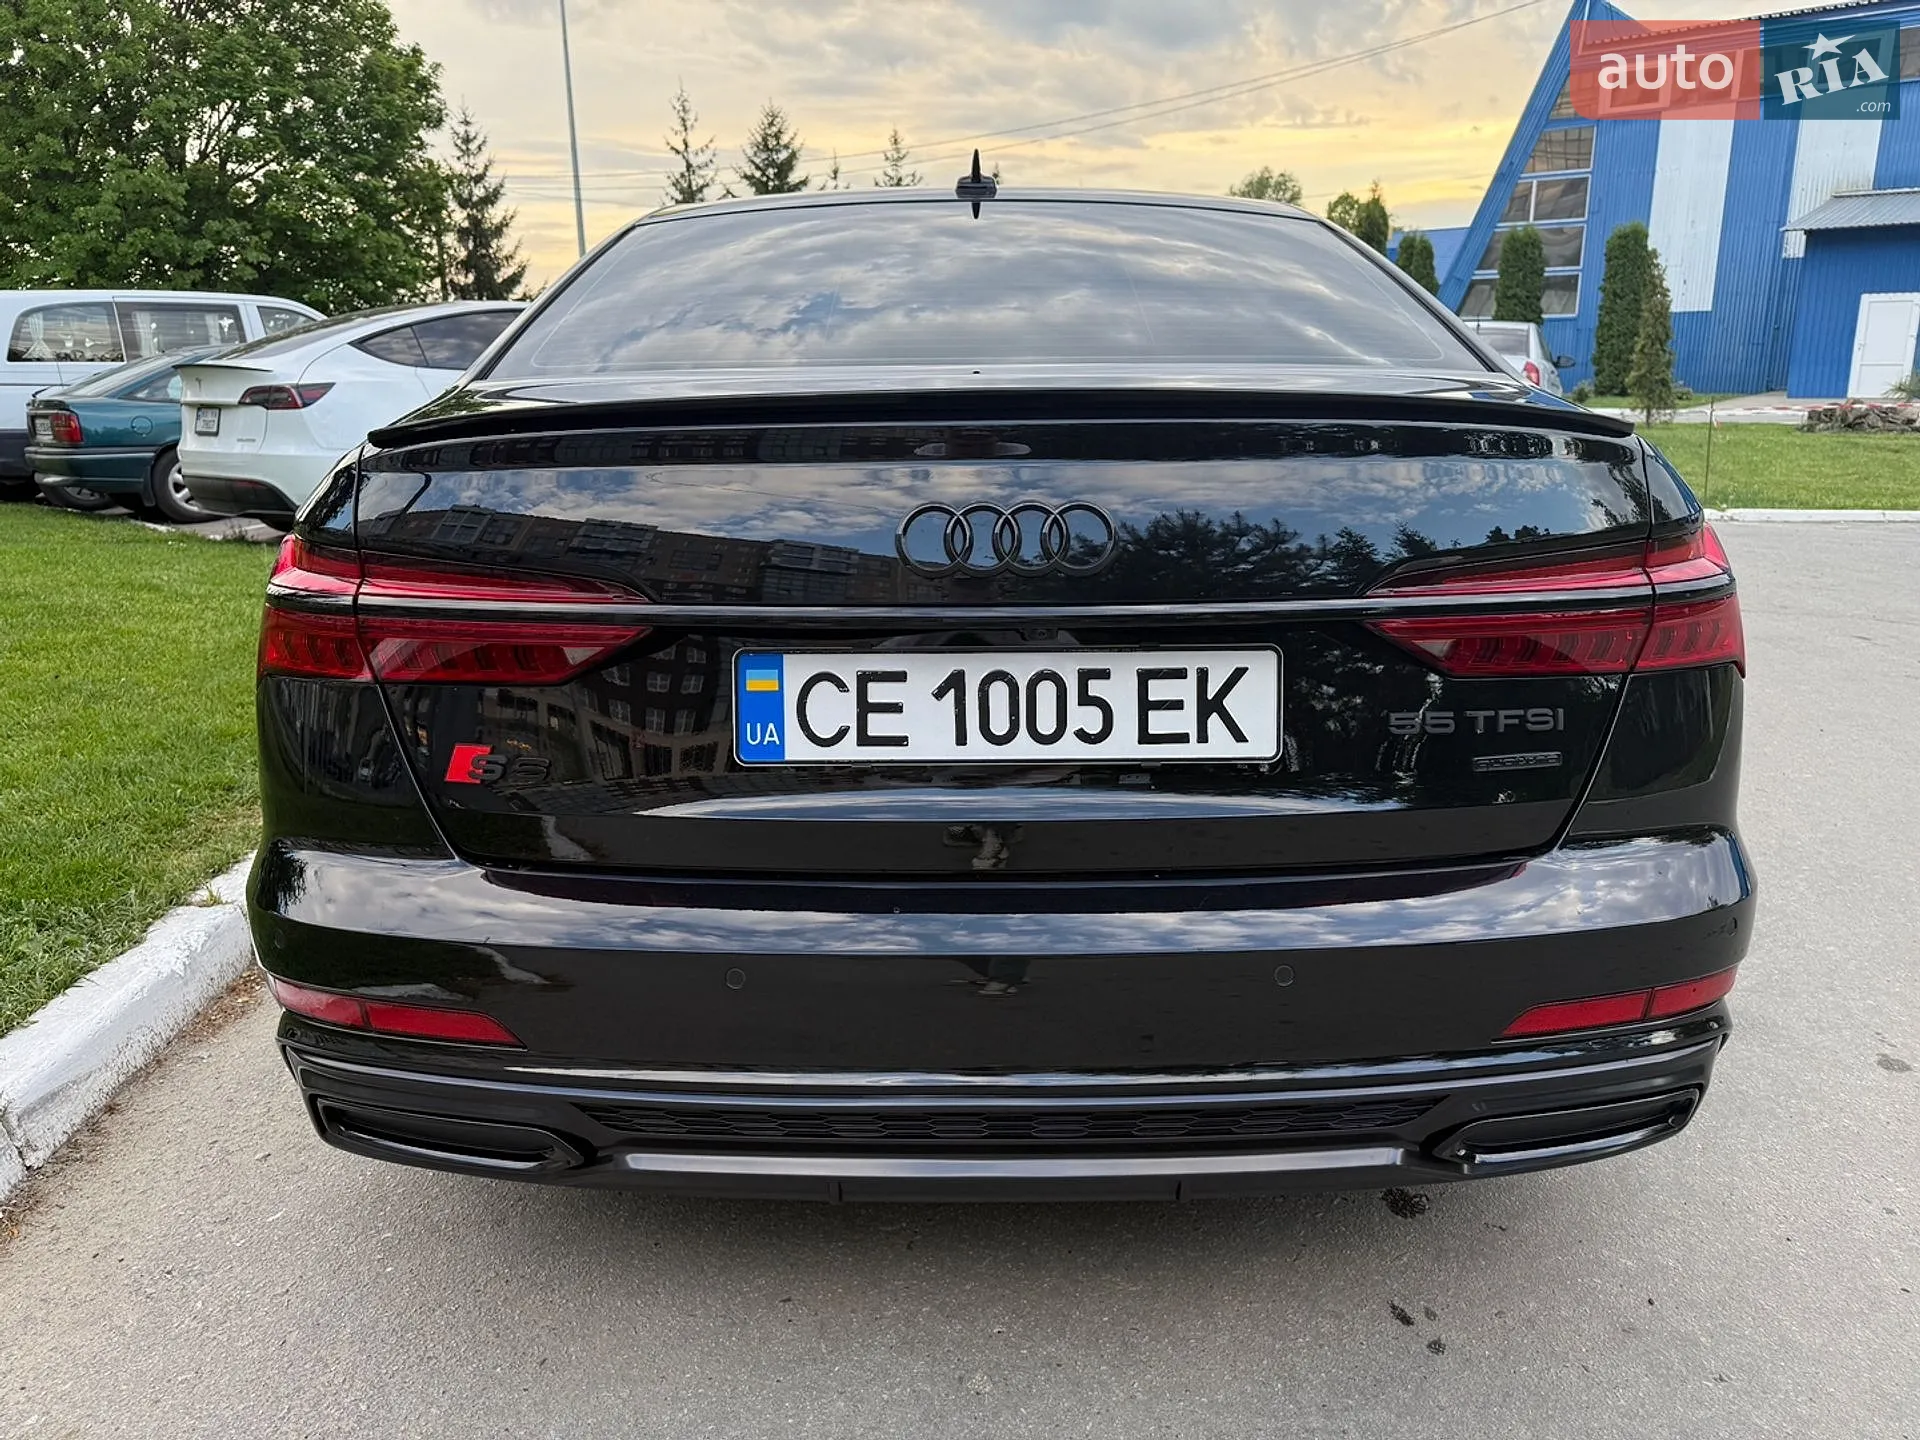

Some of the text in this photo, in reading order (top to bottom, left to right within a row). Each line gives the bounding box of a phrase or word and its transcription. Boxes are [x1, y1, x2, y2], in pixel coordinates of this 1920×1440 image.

[796, 666, 1249, 748] CE 1005 EK
[1388, 707, 1564, 735] 55 TFSI
[746, 722, 779, 746] UA
